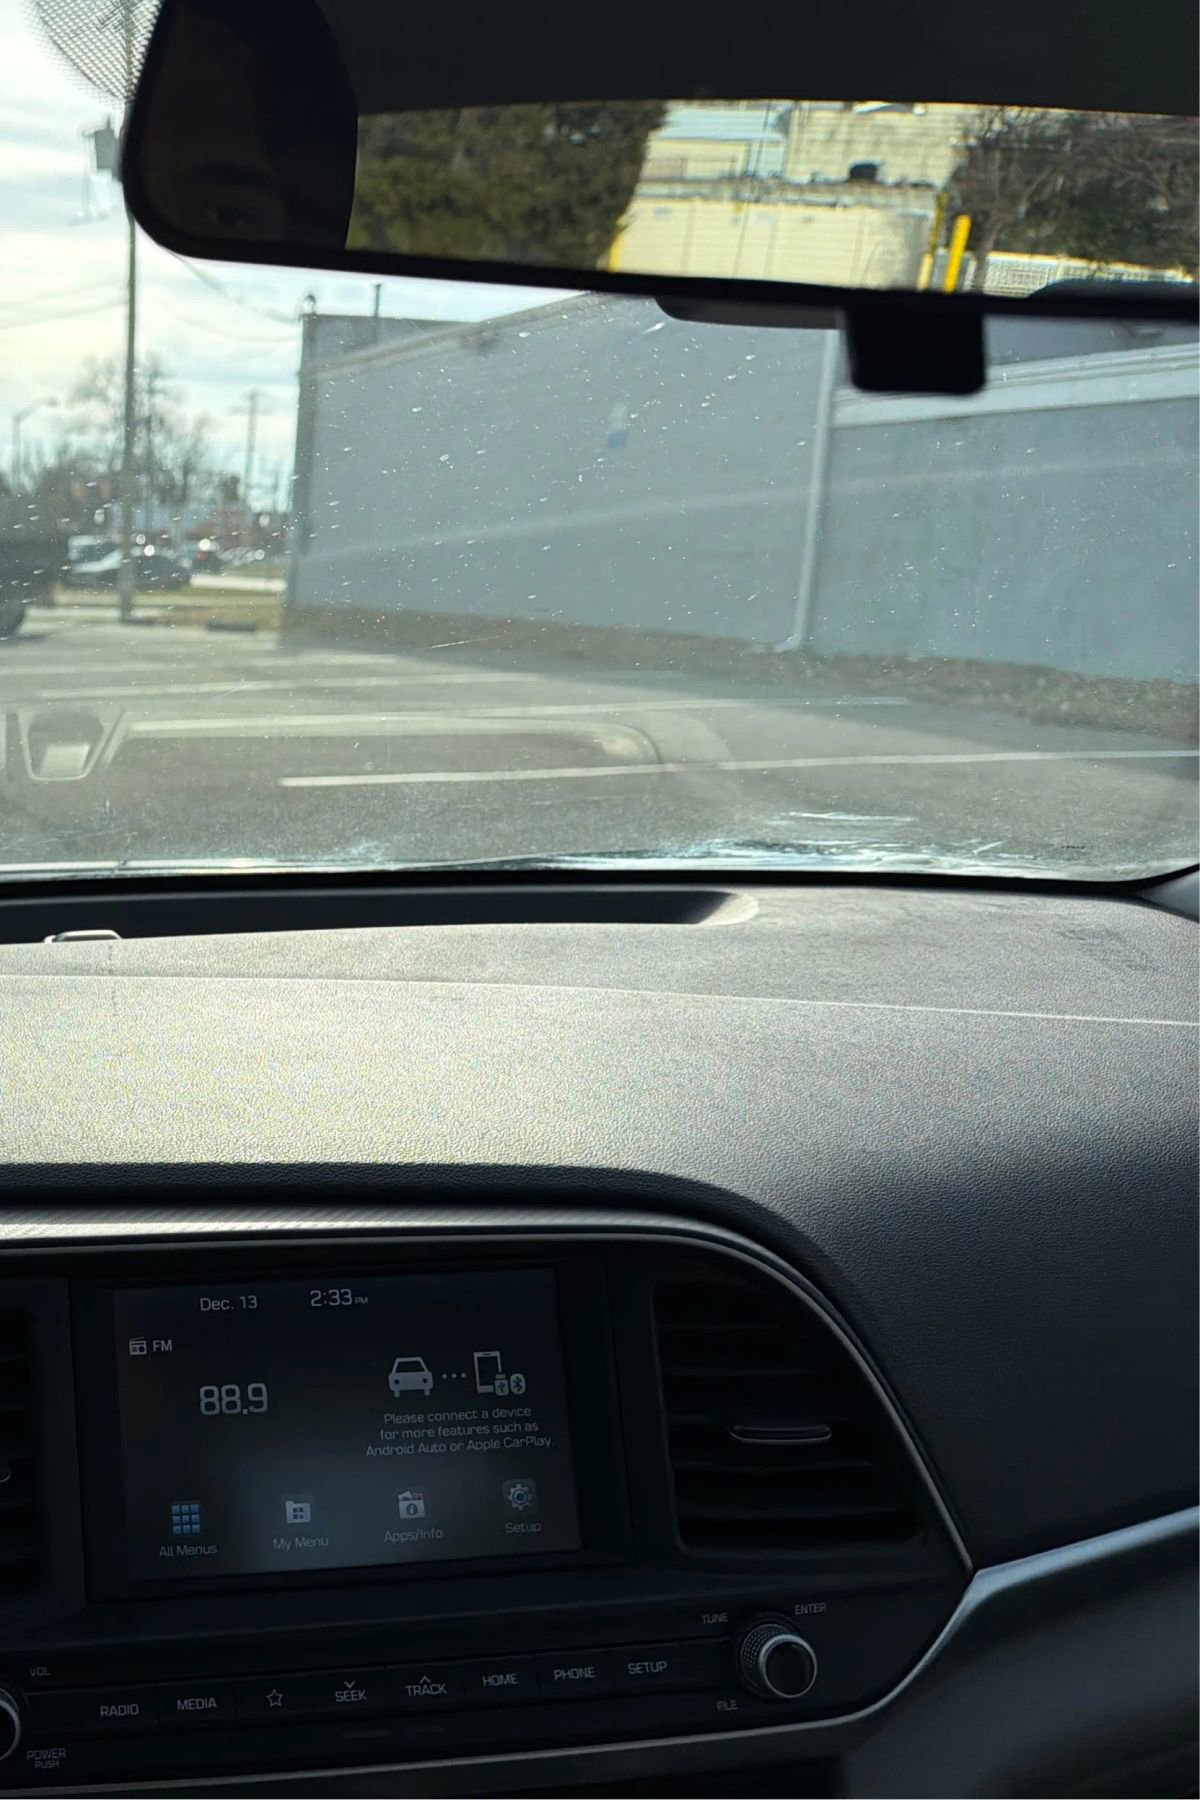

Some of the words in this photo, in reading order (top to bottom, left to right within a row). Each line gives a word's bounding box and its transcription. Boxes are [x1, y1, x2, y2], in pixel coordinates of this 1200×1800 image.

[200, 1297, 235, 1311] Dec.
[239, 1295, 258, 1309] 13
[310, 1288, 352, 1307] 2:33
[152, 1339, 173, 1352] FM
[200, 1383, 268, 1415] 88.9
[383, 1413, 425, 1425] Please
[427, 1409, 478, 1423] connect
[481, 1411, 490, 1419] a
[491, 1406, 532, 1418] device
[379, 1429, 400, 1441] for
[402, 1430, 435, 1440] more
[437, 1424, 491, 1437] features
[492, 1421, 522, 1434] such
[524, 1422, 540, 1432] as
[366, 1444, 415, 1457] Android
[418, 1441, 448, 1454] Auto
[449, 1442, 465, 1452] or
[466, 1439, 501, 1452] Apple
[383, 1527, 444, 1544] Apps/Info
[505, 1521, 542, 1535] Setup
[158, 1545, 176, 1558] All
[176, 1543, 218, 1557] Menus
[273, 1537, 291, 1552] My
[293, 1535, 329, 1550] Menu
[794, 1602, 827, 1616] ENTER
[702, 1612, 728, 1625] TUNE
[28, 1665, 52, 1678] VOL
[553, 1666, 597, 1681] PHONE
[627, 1660, 668, 1676] SETUP
[482, 1672, 519, 1687] HOME
[334, 1688, 368, 1703] SEEK
[404, 1682, 448, 1697] TRACK
[100, 1703, 140, 1718] RADIO
[176, 1697, 218, 1712] MEDIA
[715, 1700, 739, 1712] FILE
[26, 1748, 66, 1761] POWER
[34, 1759, 60, 1770] PUSH
